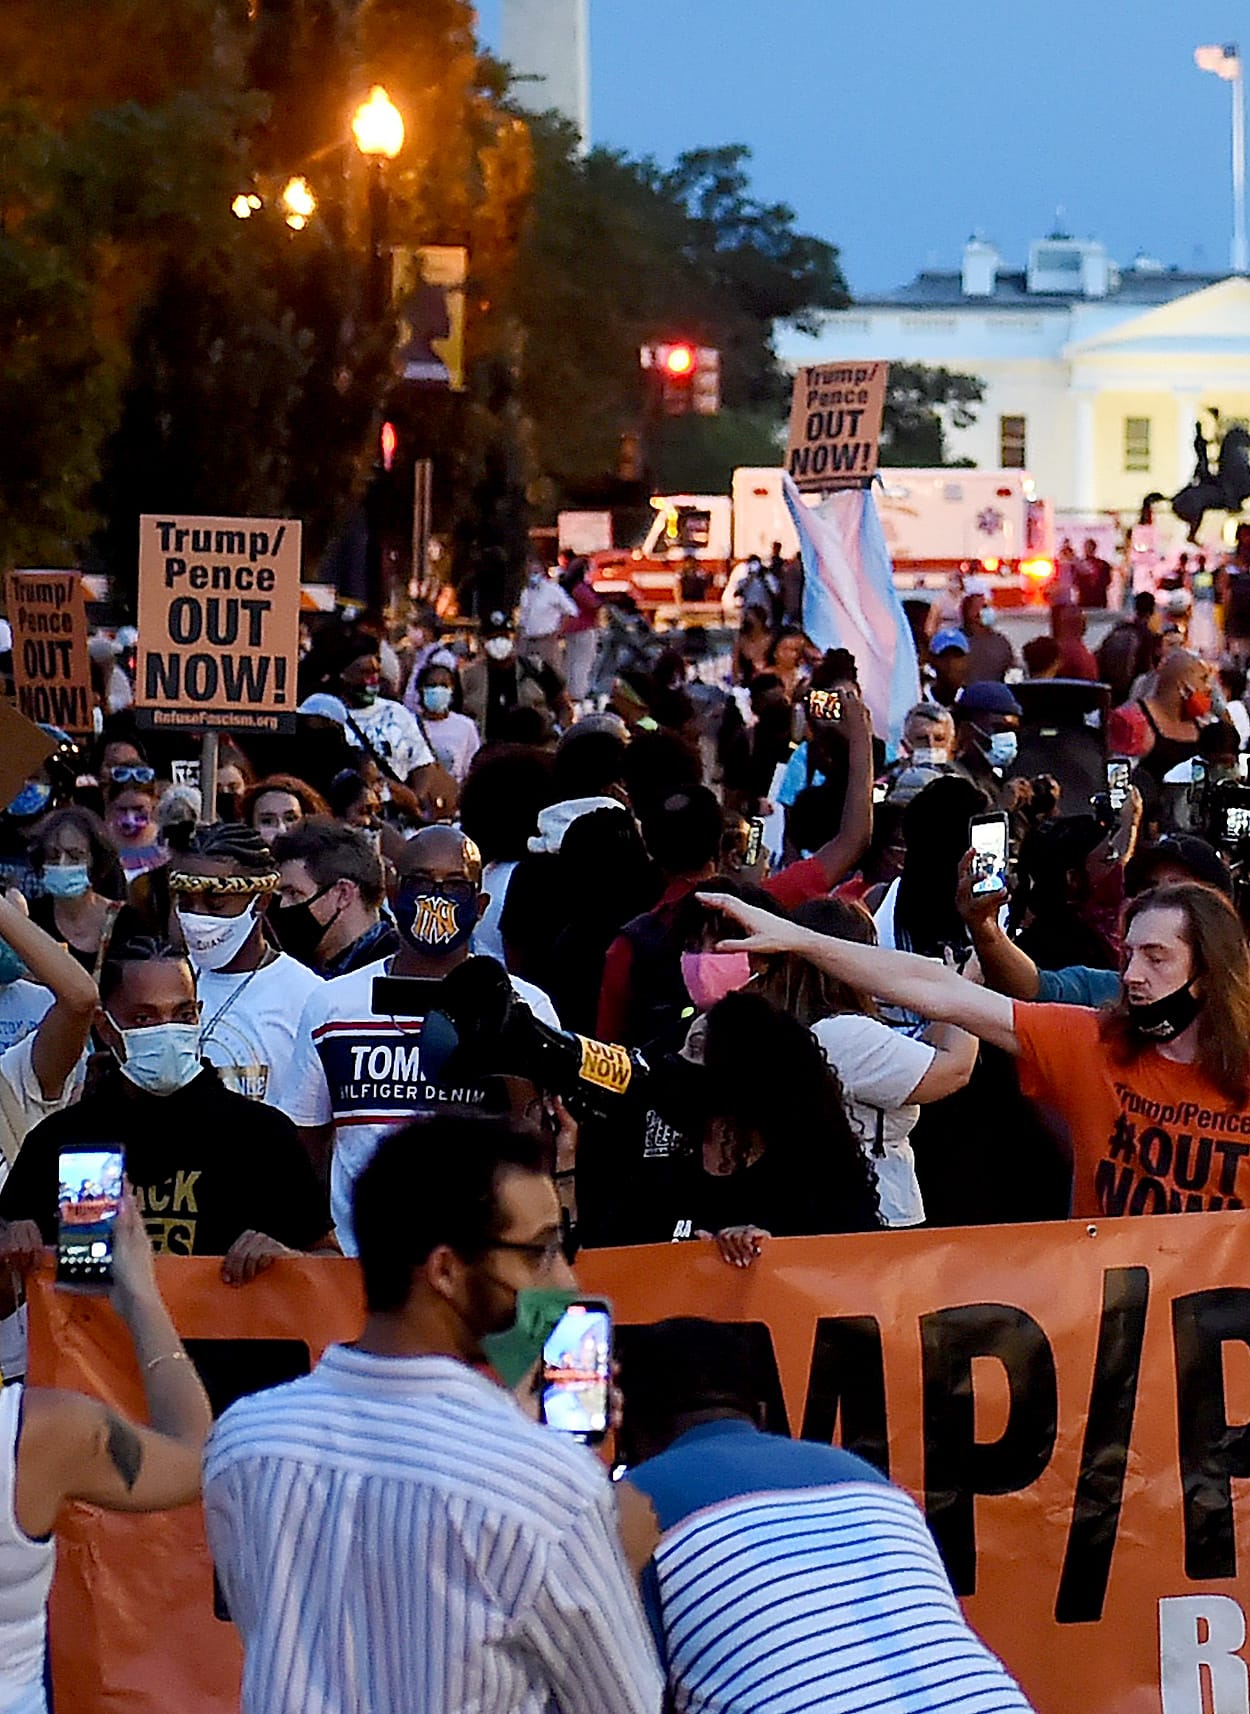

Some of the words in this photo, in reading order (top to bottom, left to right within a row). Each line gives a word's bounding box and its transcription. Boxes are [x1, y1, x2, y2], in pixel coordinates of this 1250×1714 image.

[806, 363, 878, 386] Trump/
[807, 390, 868, 409] Pence
[807, 409, 864, 441] OUT
[789, 442, 871, 477] NOW!
[155, 521, 286, 561] Trump/
[165, 557, 276, 591] Pence
[12, 576, 74, 609] Trump/
[18, 607, 74, 633] Pence
[168, 596, 271, 647] OUT
[23, 639, 74, 679] OUT
[145, 651, 287, 703] NOW!
[18, 686, 89, 725] NOW!
[154, 710, 278, 730] RefuseFascism.org
[351, 1045, 426, 1082] TOM
[583, 1052, 630, 1086] NOW
[1109, 1112, 1250, 1195] #OUT
[673, 1219, 692, 1237] BA
